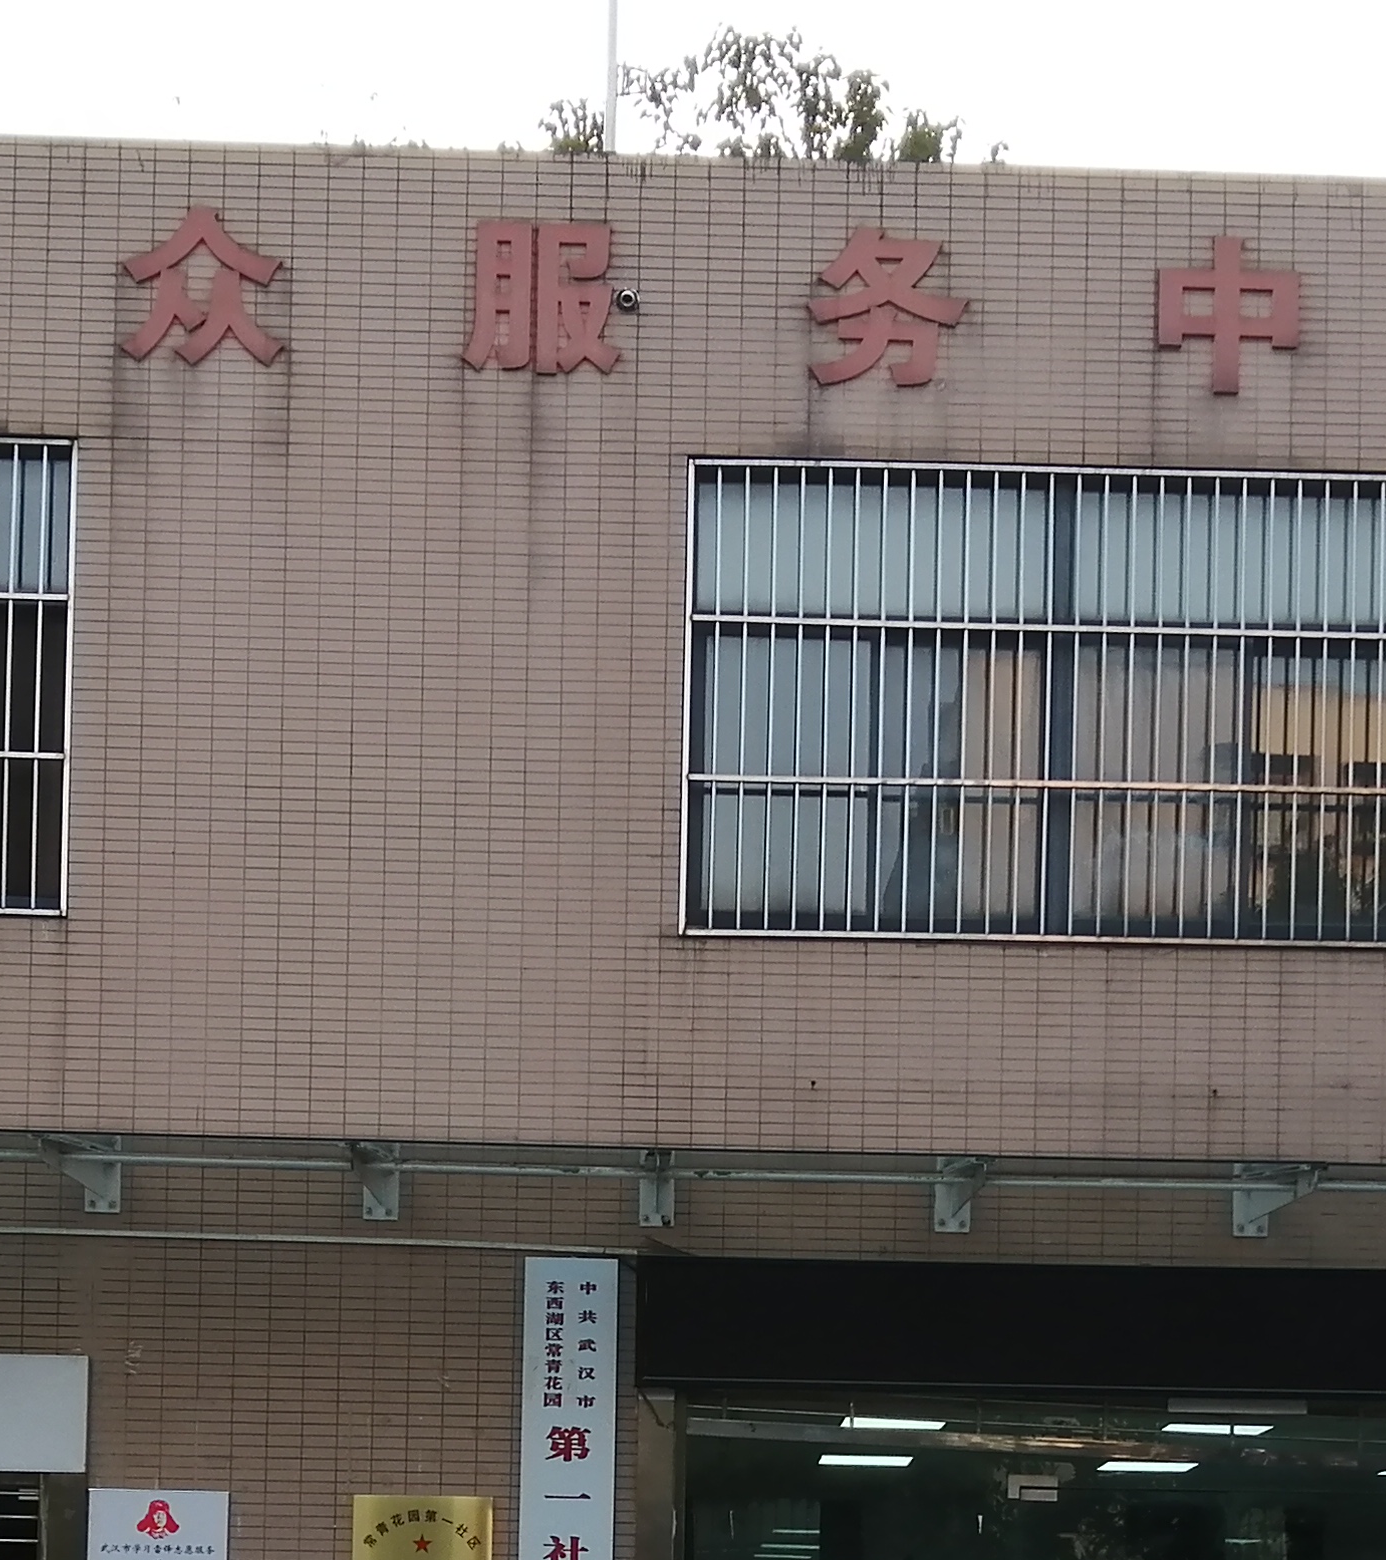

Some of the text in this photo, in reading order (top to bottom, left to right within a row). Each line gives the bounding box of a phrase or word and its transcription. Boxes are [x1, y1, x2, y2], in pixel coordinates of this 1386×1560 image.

[543, 1281, 564, 1408] 东西湖区常青花园
[576, 1281, 598, 1409] 中共武汉市
[100, 1543, 215, 1555] 武汉市学习雷锋志愿服务
[363, 1509, 481, 1550] 常青花园第一社区
